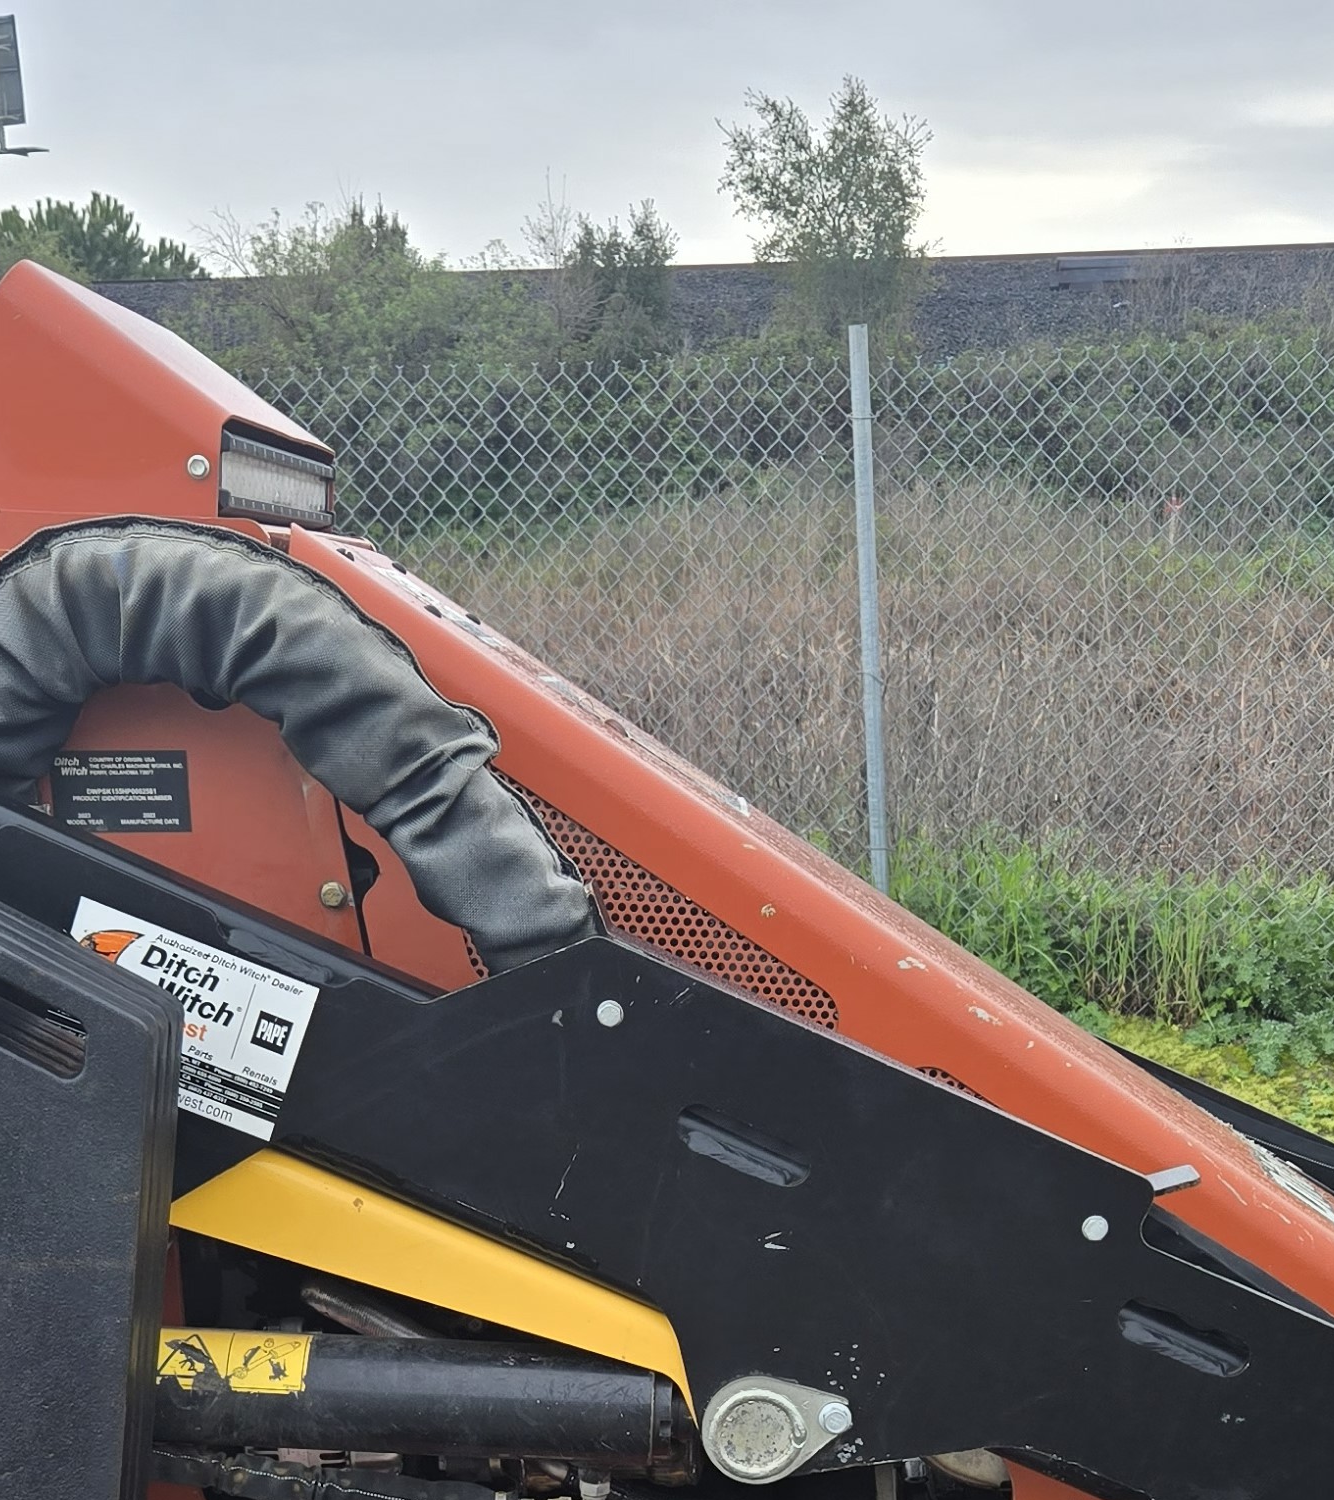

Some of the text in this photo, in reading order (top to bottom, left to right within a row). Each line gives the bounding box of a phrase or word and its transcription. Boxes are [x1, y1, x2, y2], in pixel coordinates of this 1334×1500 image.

[54, 756, 80, 767] Ditch
[60, 766, 88, 776] Witch
[140, 943, 221, 993] Ditch
[210, 954, 237, 971] Ditch
[271, 977, 304, 996] Dealer
[187, 1044, 214, 1062] Parts
[241, 1065, 279, 1087] Rentals
[178, 1095, 233, 1122] vest.com
